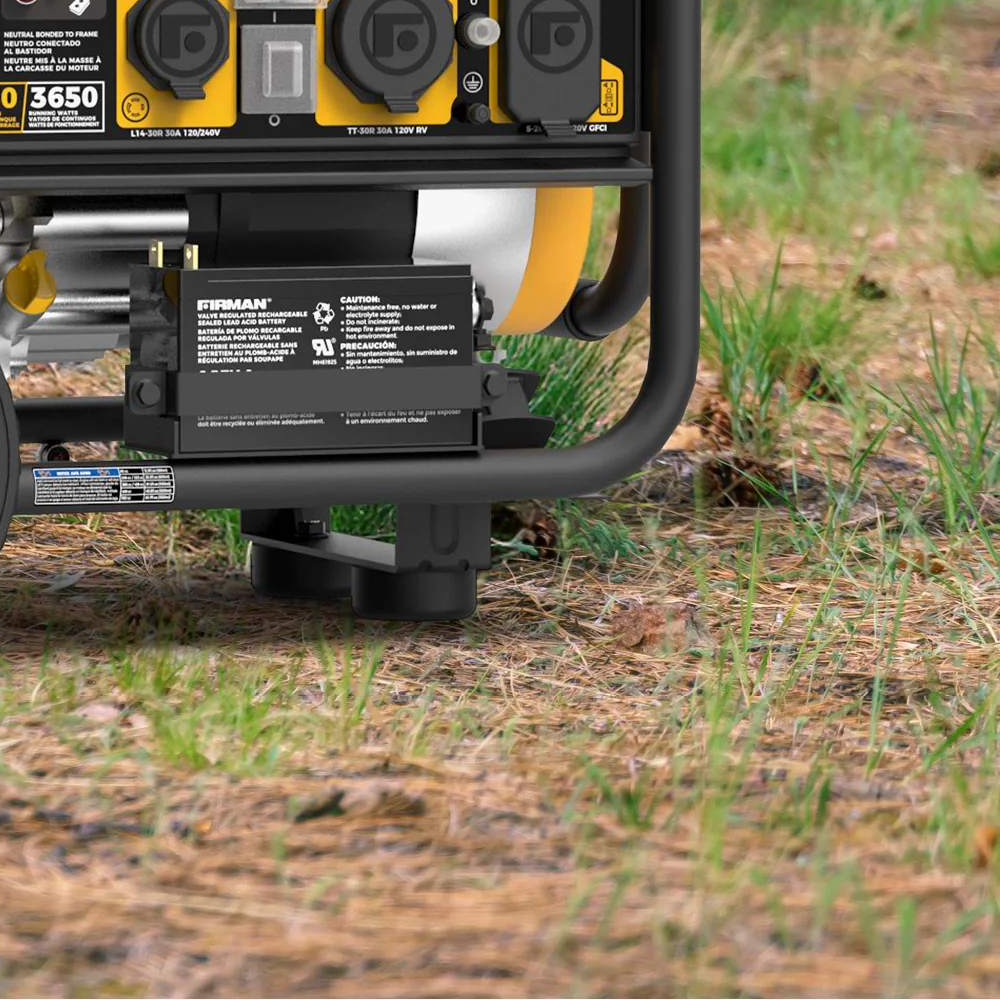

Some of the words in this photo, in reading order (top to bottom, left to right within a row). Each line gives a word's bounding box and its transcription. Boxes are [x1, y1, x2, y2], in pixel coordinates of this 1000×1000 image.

[30, 86, 98, 109] 3650
[589, 124, 607, 132] GFCI
[183, 129, 220, 137] 120/240V
[197, 298, 267, 311] FIRMAN
[346, 311, 379, 319] electrolyte
[340, 341, 397, 350] PRECAUCIÓN:
[198, 356, 238, 364] RÉGULATION
